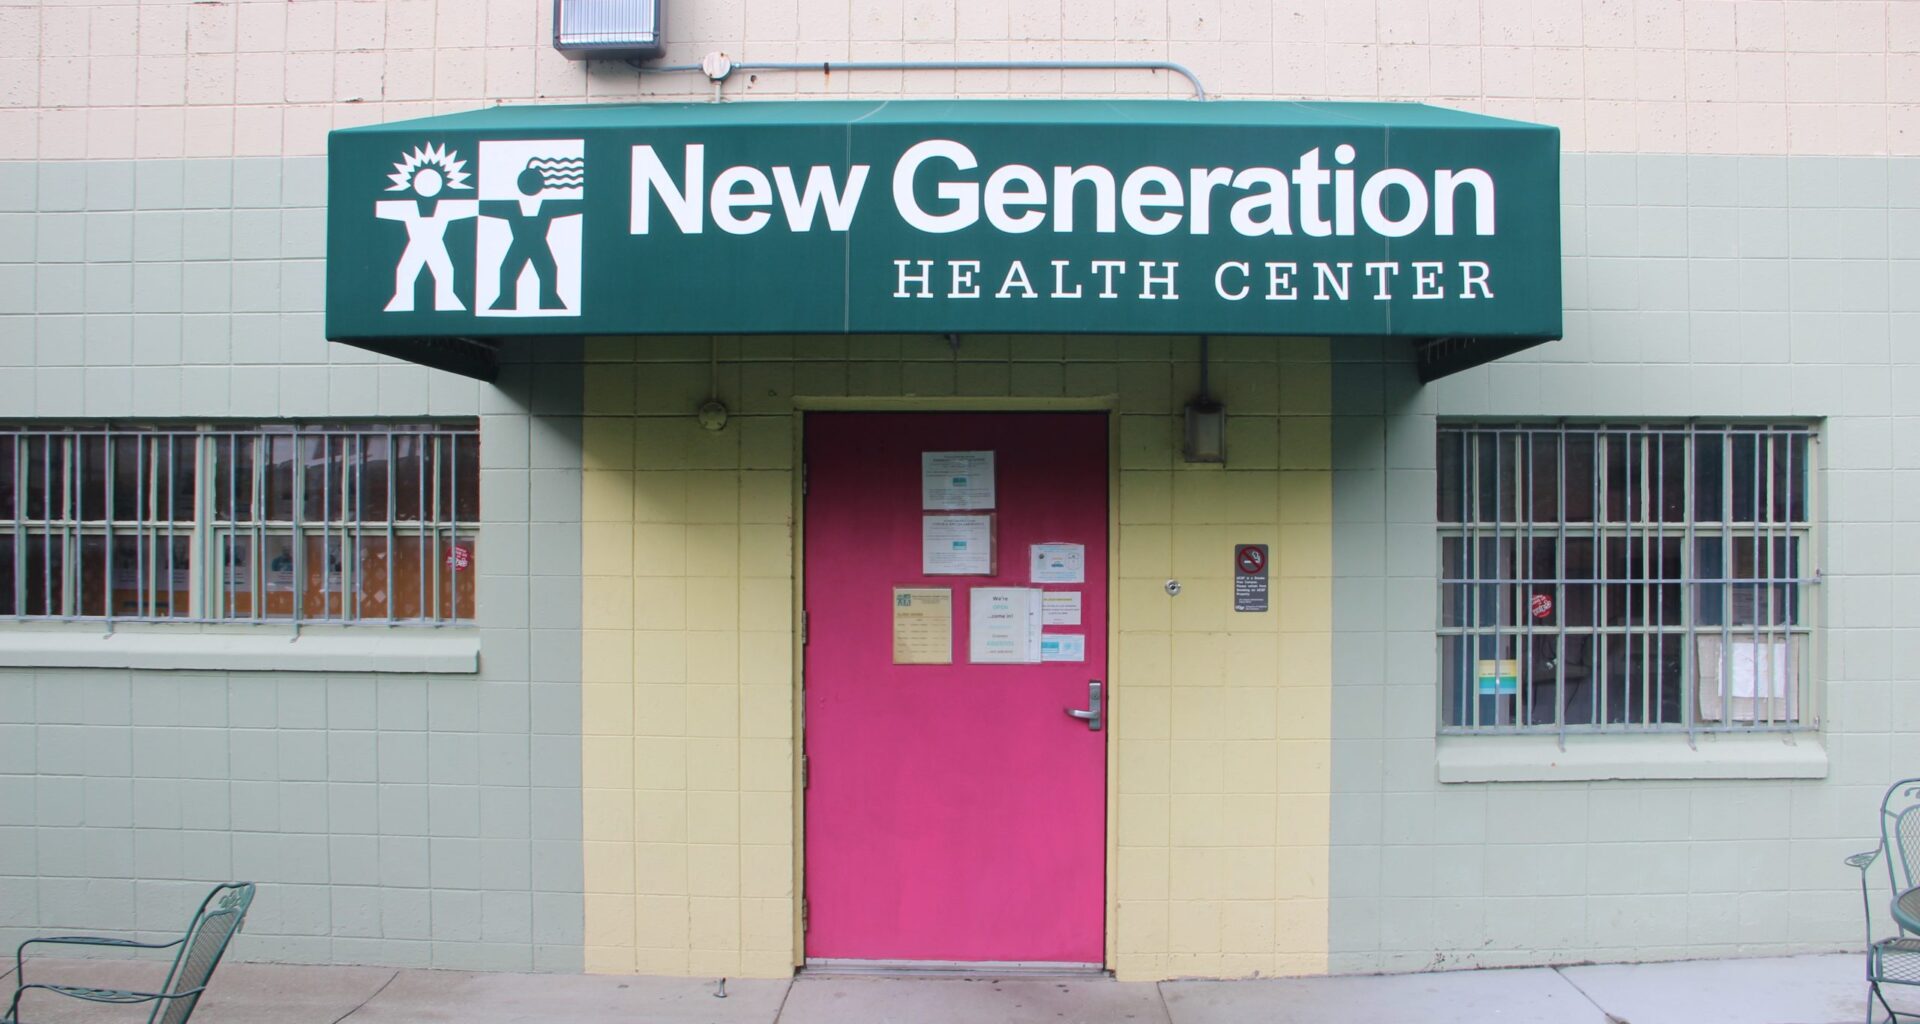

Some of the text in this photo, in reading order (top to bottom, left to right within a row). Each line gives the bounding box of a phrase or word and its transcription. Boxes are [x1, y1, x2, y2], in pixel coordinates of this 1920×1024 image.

[630, 140, 1495, 238] New Generation
[893, 259, 1496, 301] HEALTH CENTER
